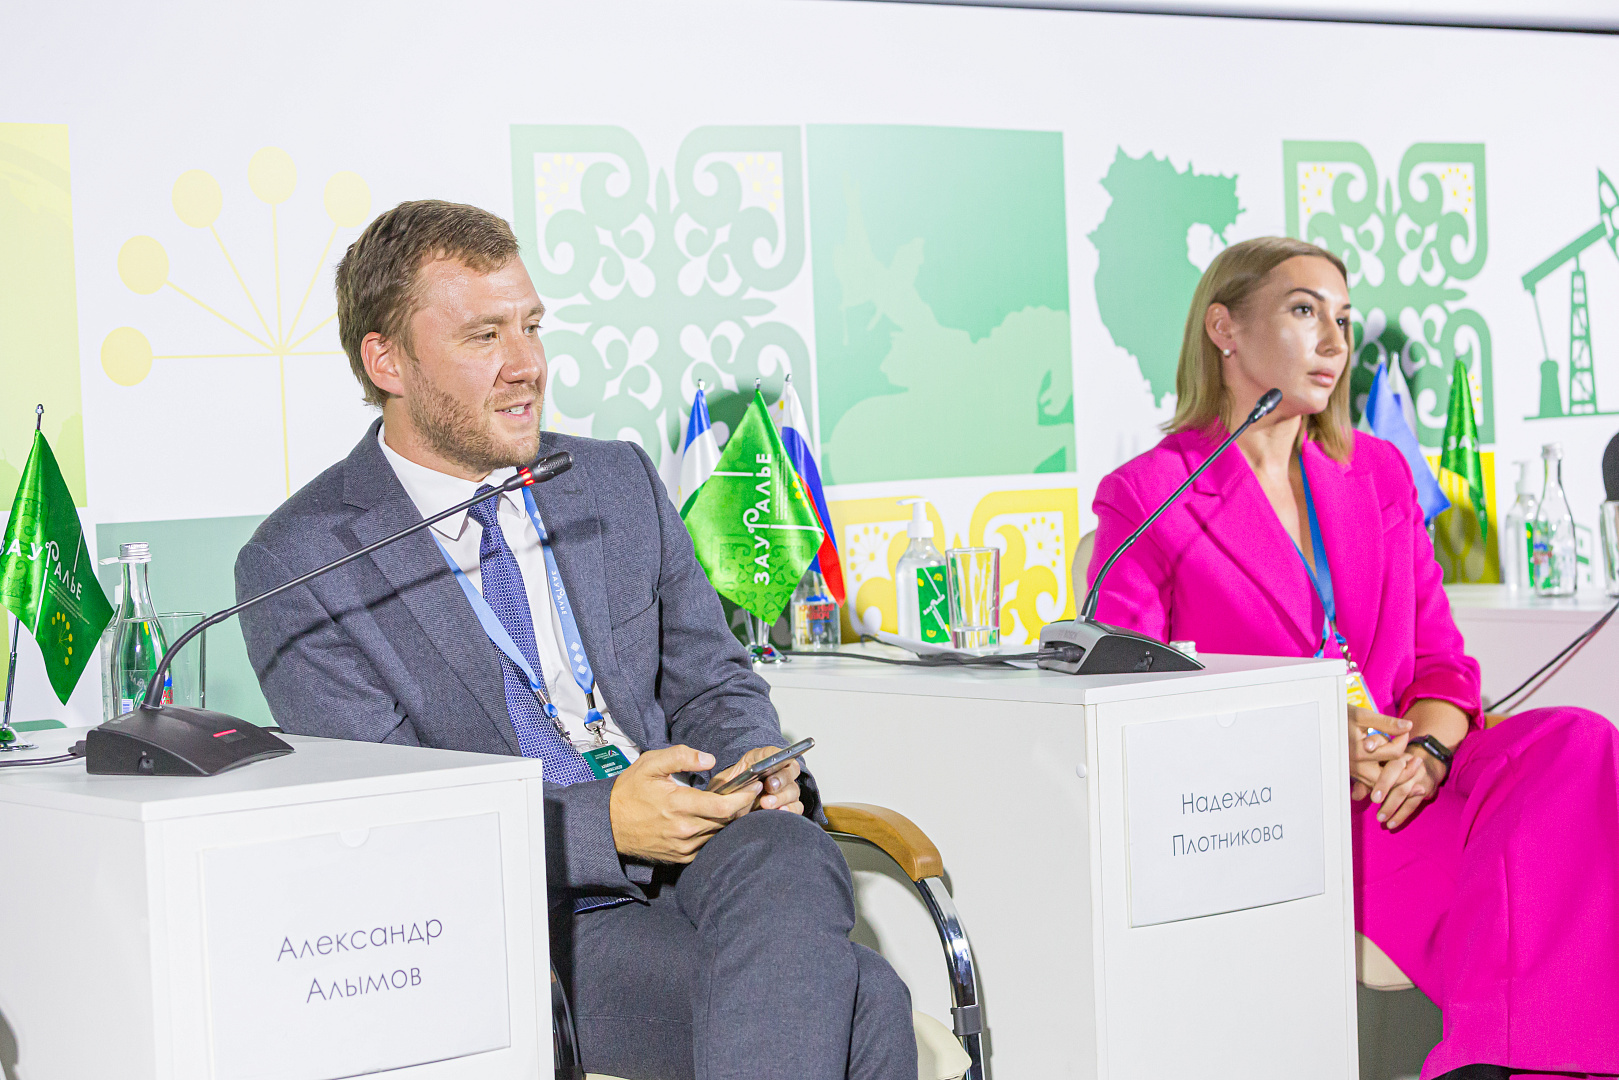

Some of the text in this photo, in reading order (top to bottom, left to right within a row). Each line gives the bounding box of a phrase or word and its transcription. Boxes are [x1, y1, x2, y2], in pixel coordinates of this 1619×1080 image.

[1181, 785, 1273, 815] Надежда
[1172, 822, 1284, 857] Плотникова
[276, 918, 444, 962] Александр
[306, 967, 423, 1004] Алымов
